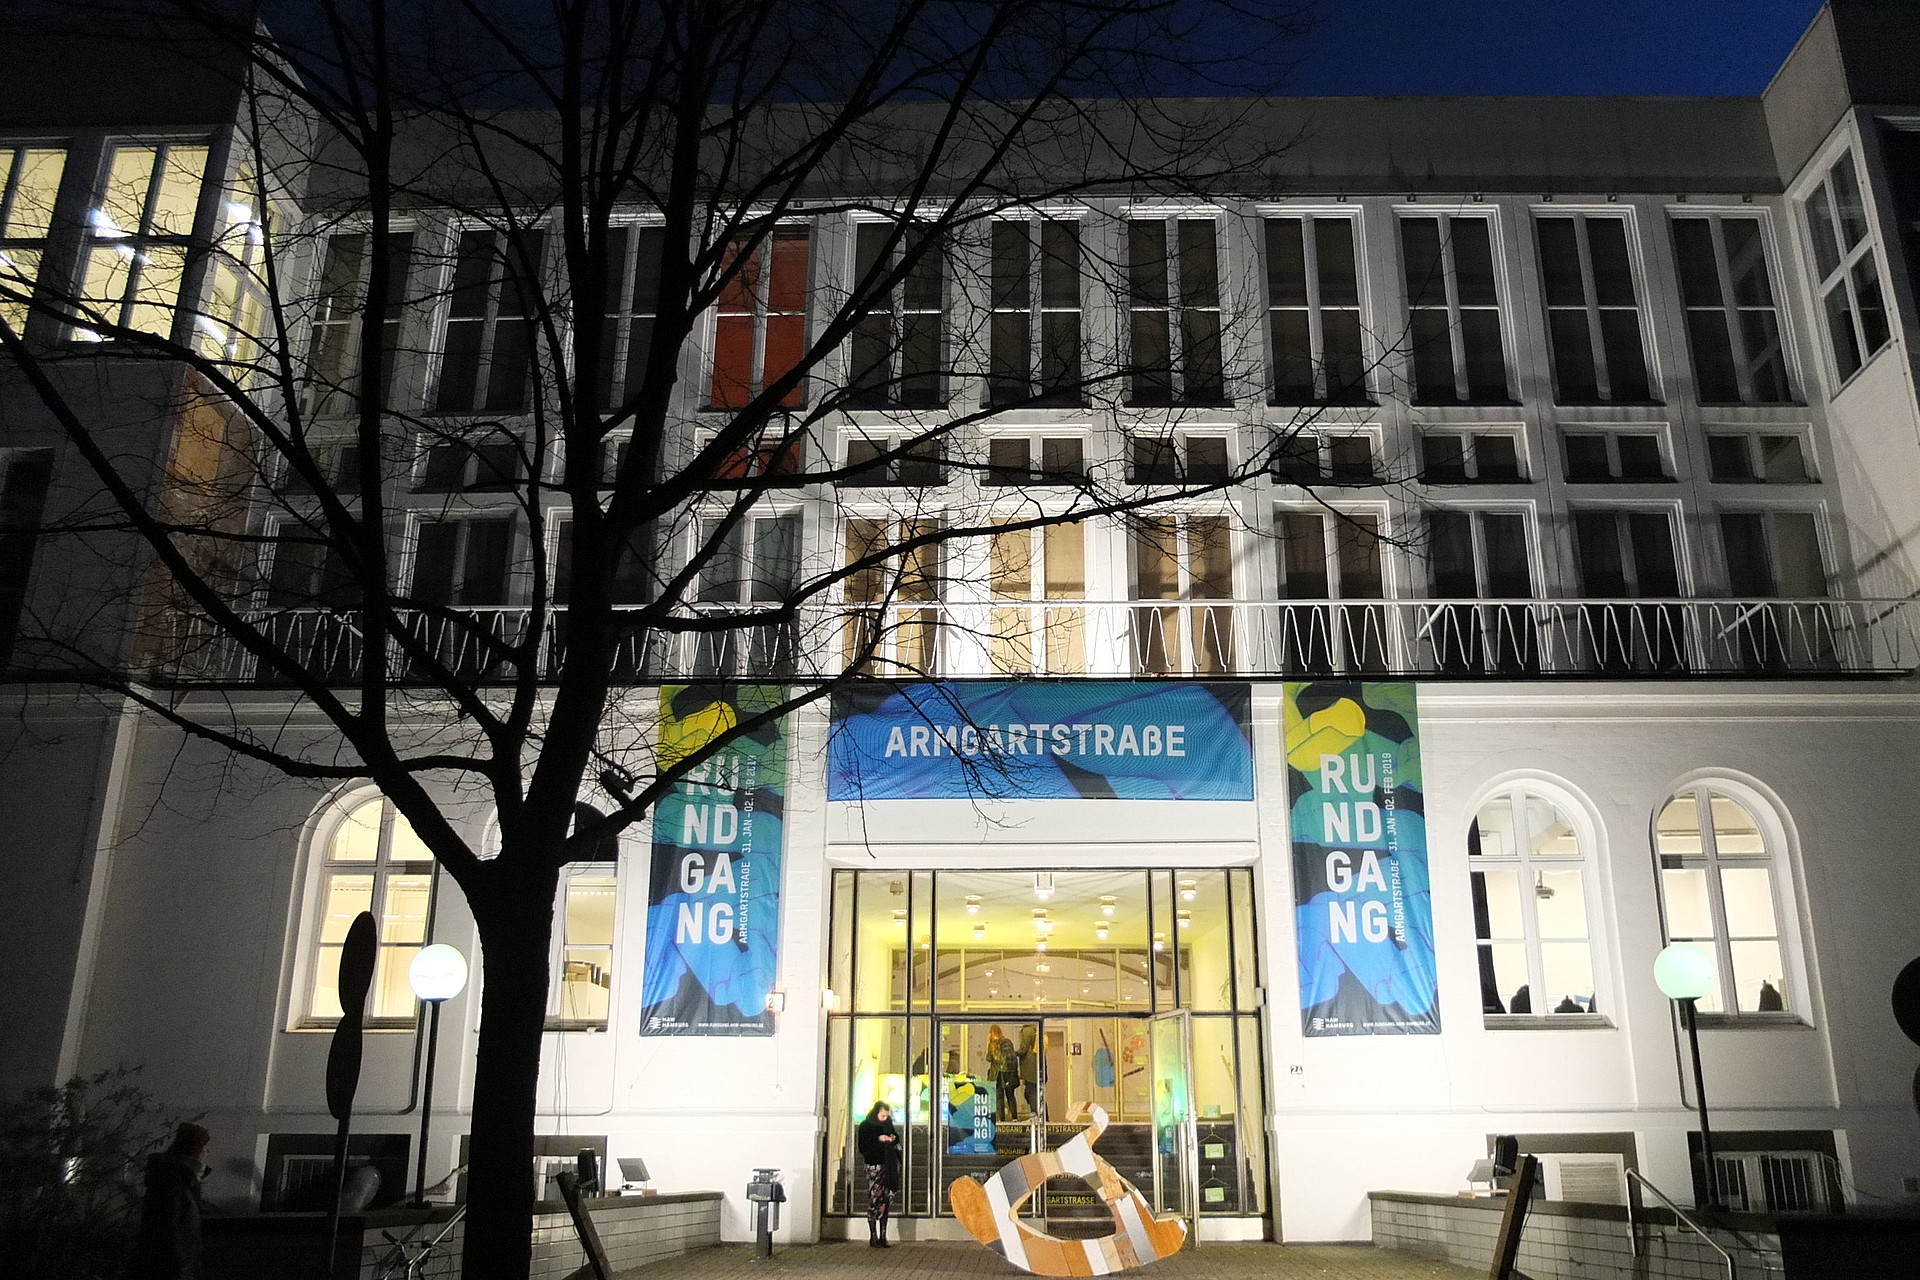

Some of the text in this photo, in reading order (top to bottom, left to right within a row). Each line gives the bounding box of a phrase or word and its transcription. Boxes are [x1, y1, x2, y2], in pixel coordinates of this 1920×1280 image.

[885, 724, 1185, 757] ARMGARTSTRAßE
[686, 755, 740, 796] RU
[1319, 752, 1375, 794] RU
[1382, 752, 1393, 774] 2019
[1384, 777, 1394, 794] FEB
[684, 804, 738, 845] ND
[1322, 801, 1382, 843] ND
[742, 840, 752, 853] 31.
[1389, 838, 1398, 852] 31.
[680, 852, 737, 894] GA
[1325, 850, 1388, 893] GA
[676, 902, 734, 945] NG
[1329, 900, 1389, 944] NG
[974, 1093, 987, 1104] RU
[974, 1105, 988, 1116] ND
[974, 1116, 988, 1128] GA
[974, 1128, 988, 1139] NG
